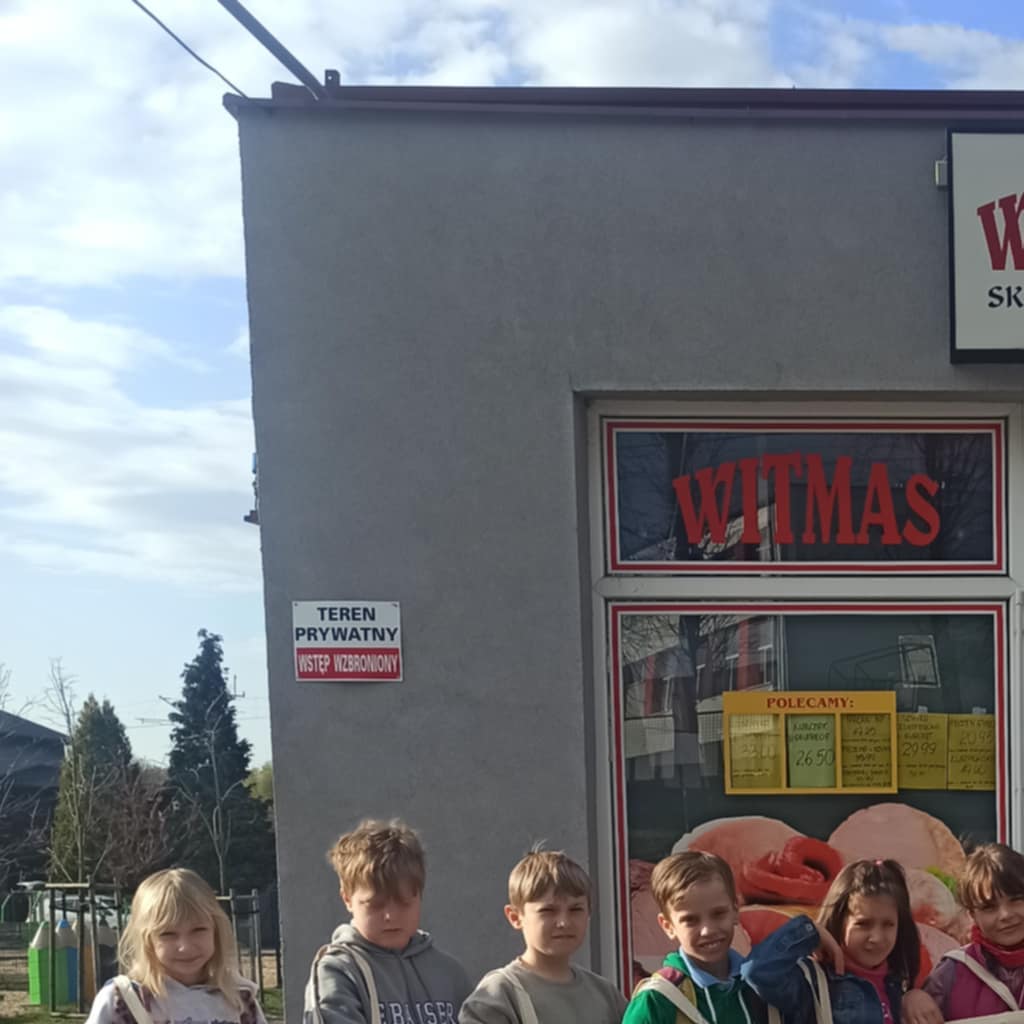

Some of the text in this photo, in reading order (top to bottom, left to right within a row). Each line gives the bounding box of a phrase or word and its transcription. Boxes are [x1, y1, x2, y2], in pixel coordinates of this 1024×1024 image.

[672, 452, 942, 547] WITMAS
[317, 606, 376, 621] TEREN
[295, 627, 398, 642] PRYWATNY
[298, 653, 399, 675] WSTĘP WZBRONIONY
[767, 697, 854, 709] POLECAMY:
